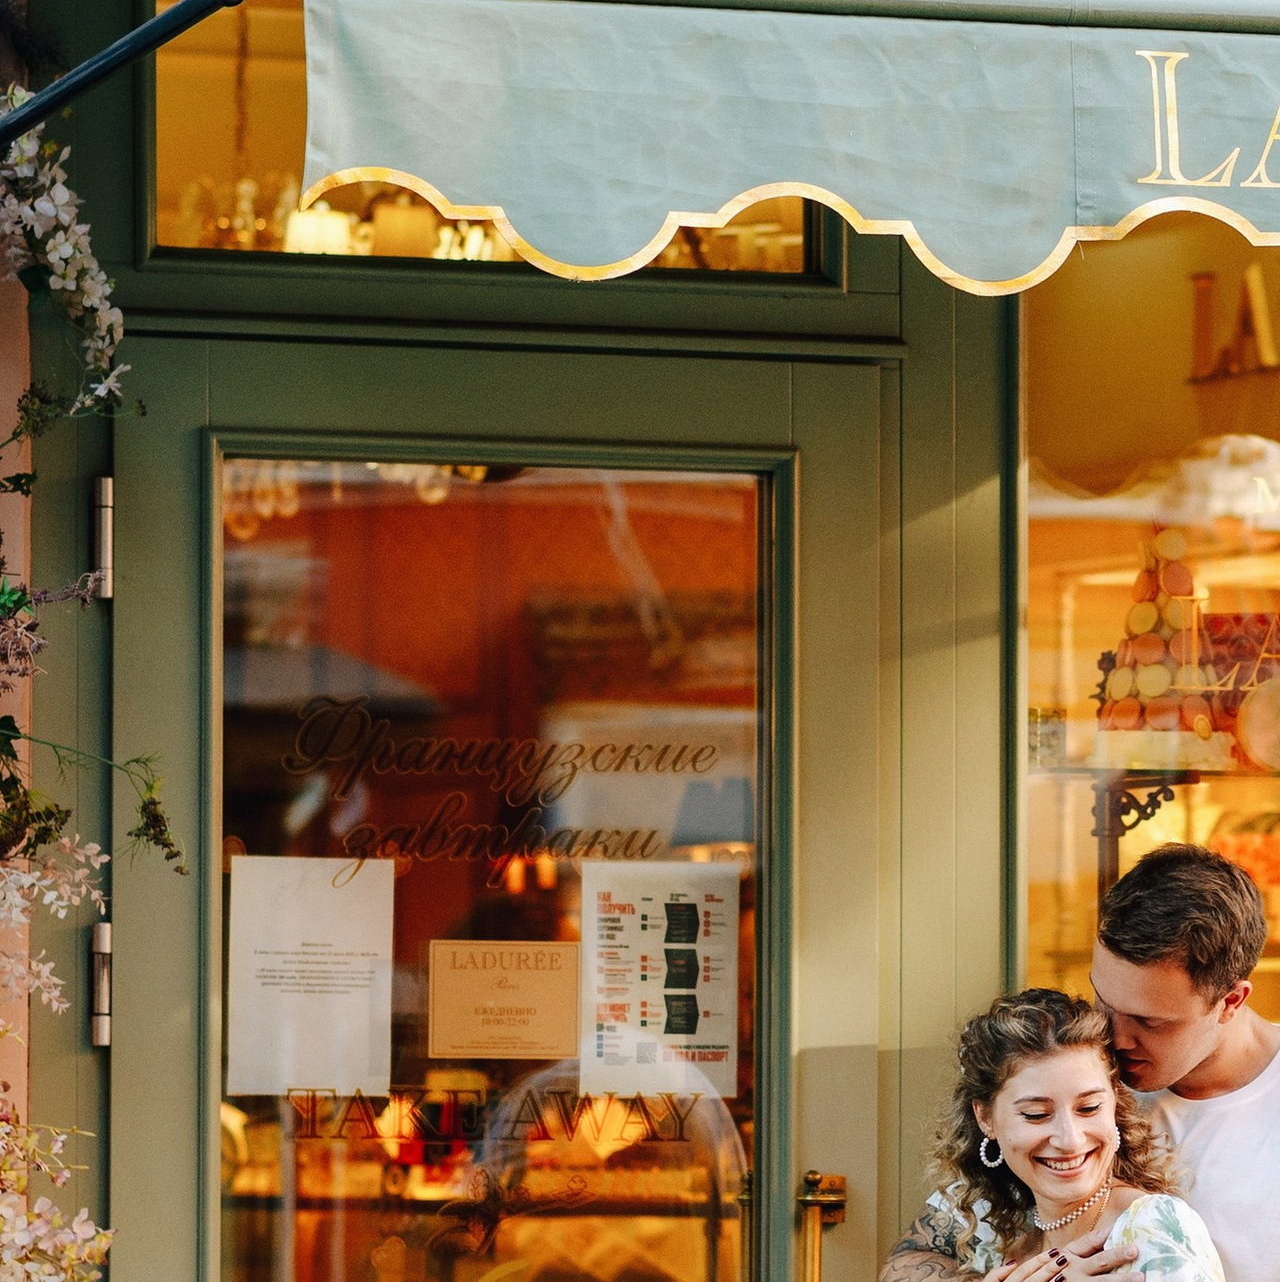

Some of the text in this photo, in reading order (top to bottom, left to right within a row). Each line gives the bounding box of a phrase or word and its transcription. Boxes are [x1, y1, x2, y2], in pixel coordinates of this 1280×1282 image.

[281, 694, 719, 808] Французские
[330, 791, 663, 889] завтраки
[450, 950, 562, 971] LADURÉE
[286, 1086, 707, 1144] TAKE AWAY
